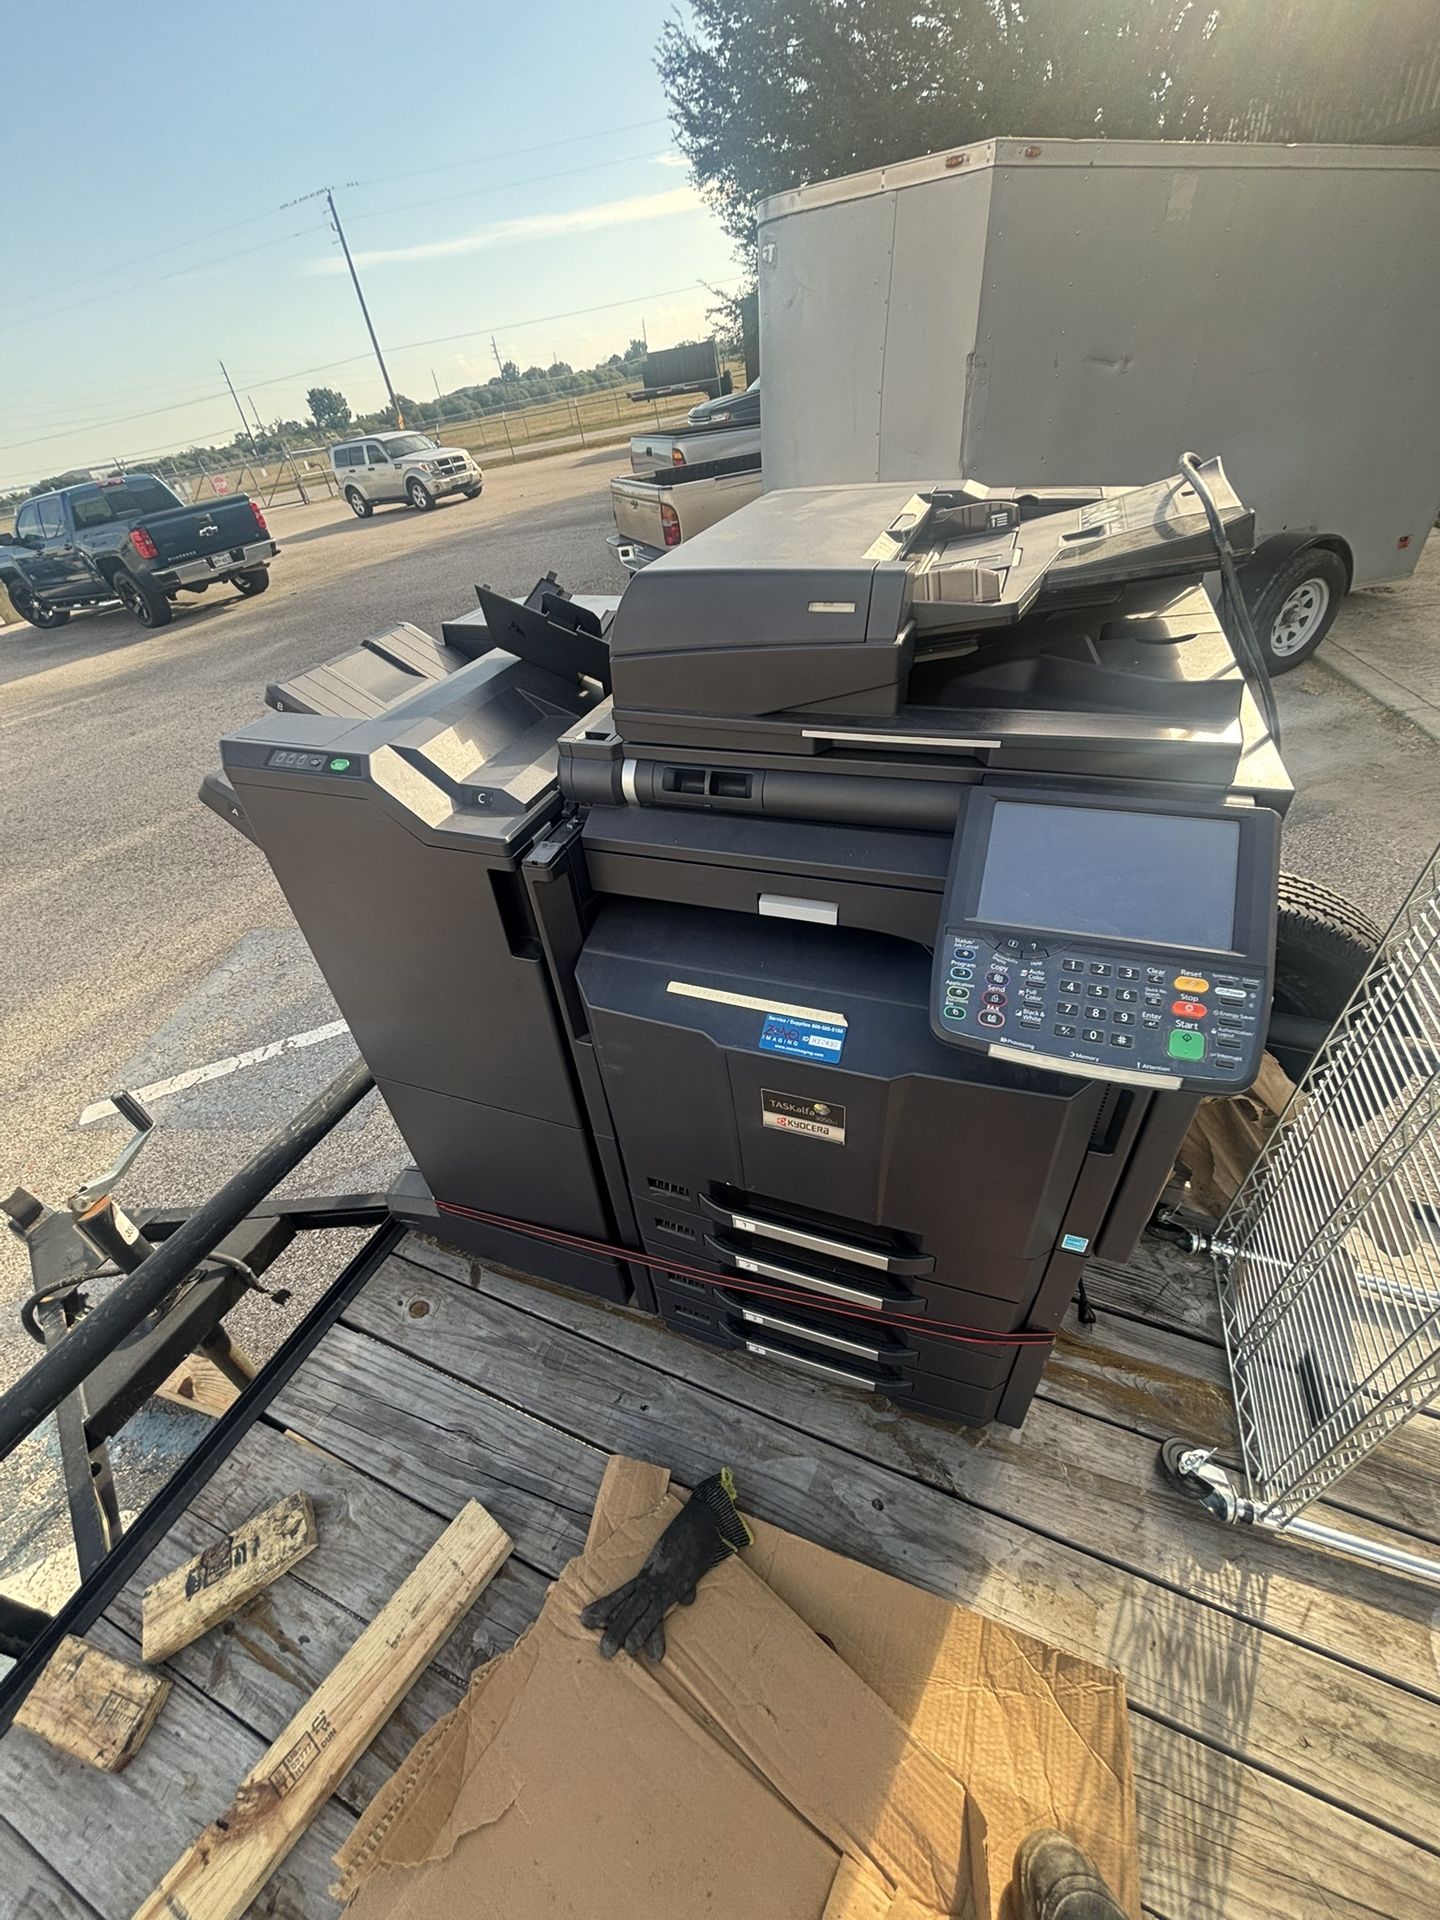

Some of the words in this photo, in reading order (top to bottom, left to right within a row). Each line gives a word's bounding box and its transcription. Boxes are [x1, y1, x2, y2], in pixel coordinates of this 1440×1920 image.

[277, 701, 283, 711] B
[478, 793, 486, 804] C
[231, 808, 239, 817] A
[951, 960, 976, 969] Program
[990, 963, 1009, 973] Copy
[1069, 961, 1076, 970] 1
[1097, 964, 1105, 974] 2
[1125, 968, 1133, 978] 3
[1146, 967, 1166, 976] Clear
[1180, 969, 1203, 978] Reset
[945, 980, 975, 988] Application
[987, 984, 1006, 993] Send
[1067, 982, 1074, 992] 4
[1095, 986, 1103, 996] 5
[1123, 990, 1131, 1000] 6
[1025, 993, 1042, 1001] Color
[1180, 993, 1199, 1003] Stop
[986, 1004, 1000, 1012] FAX
[1023, 1008, 1039, 1016] Black
[1064, 1004, 1072, 1013] 7
[1092, 1008, 1100, 1018] 8
[768, 1015, 787, 1023] Service
[1022, 1014, 1042, 1022] White
[1120, 1012, 1128, 1022] 9
[1142, 1011, 1162, 1020] Enter
[1175, 1020, 1199, 1030] Start
[1089, 1030, 1097, 1040] 0
[1117, 1035, 1127, 1045] #
[762, 1035, 799, 1046] IMAGING
[1075, 1052, 1100, 1062] Memory
[769, 1099, 816, 1117] TASKalfa
[787, 1119, 830, 1135] KYOCERA
